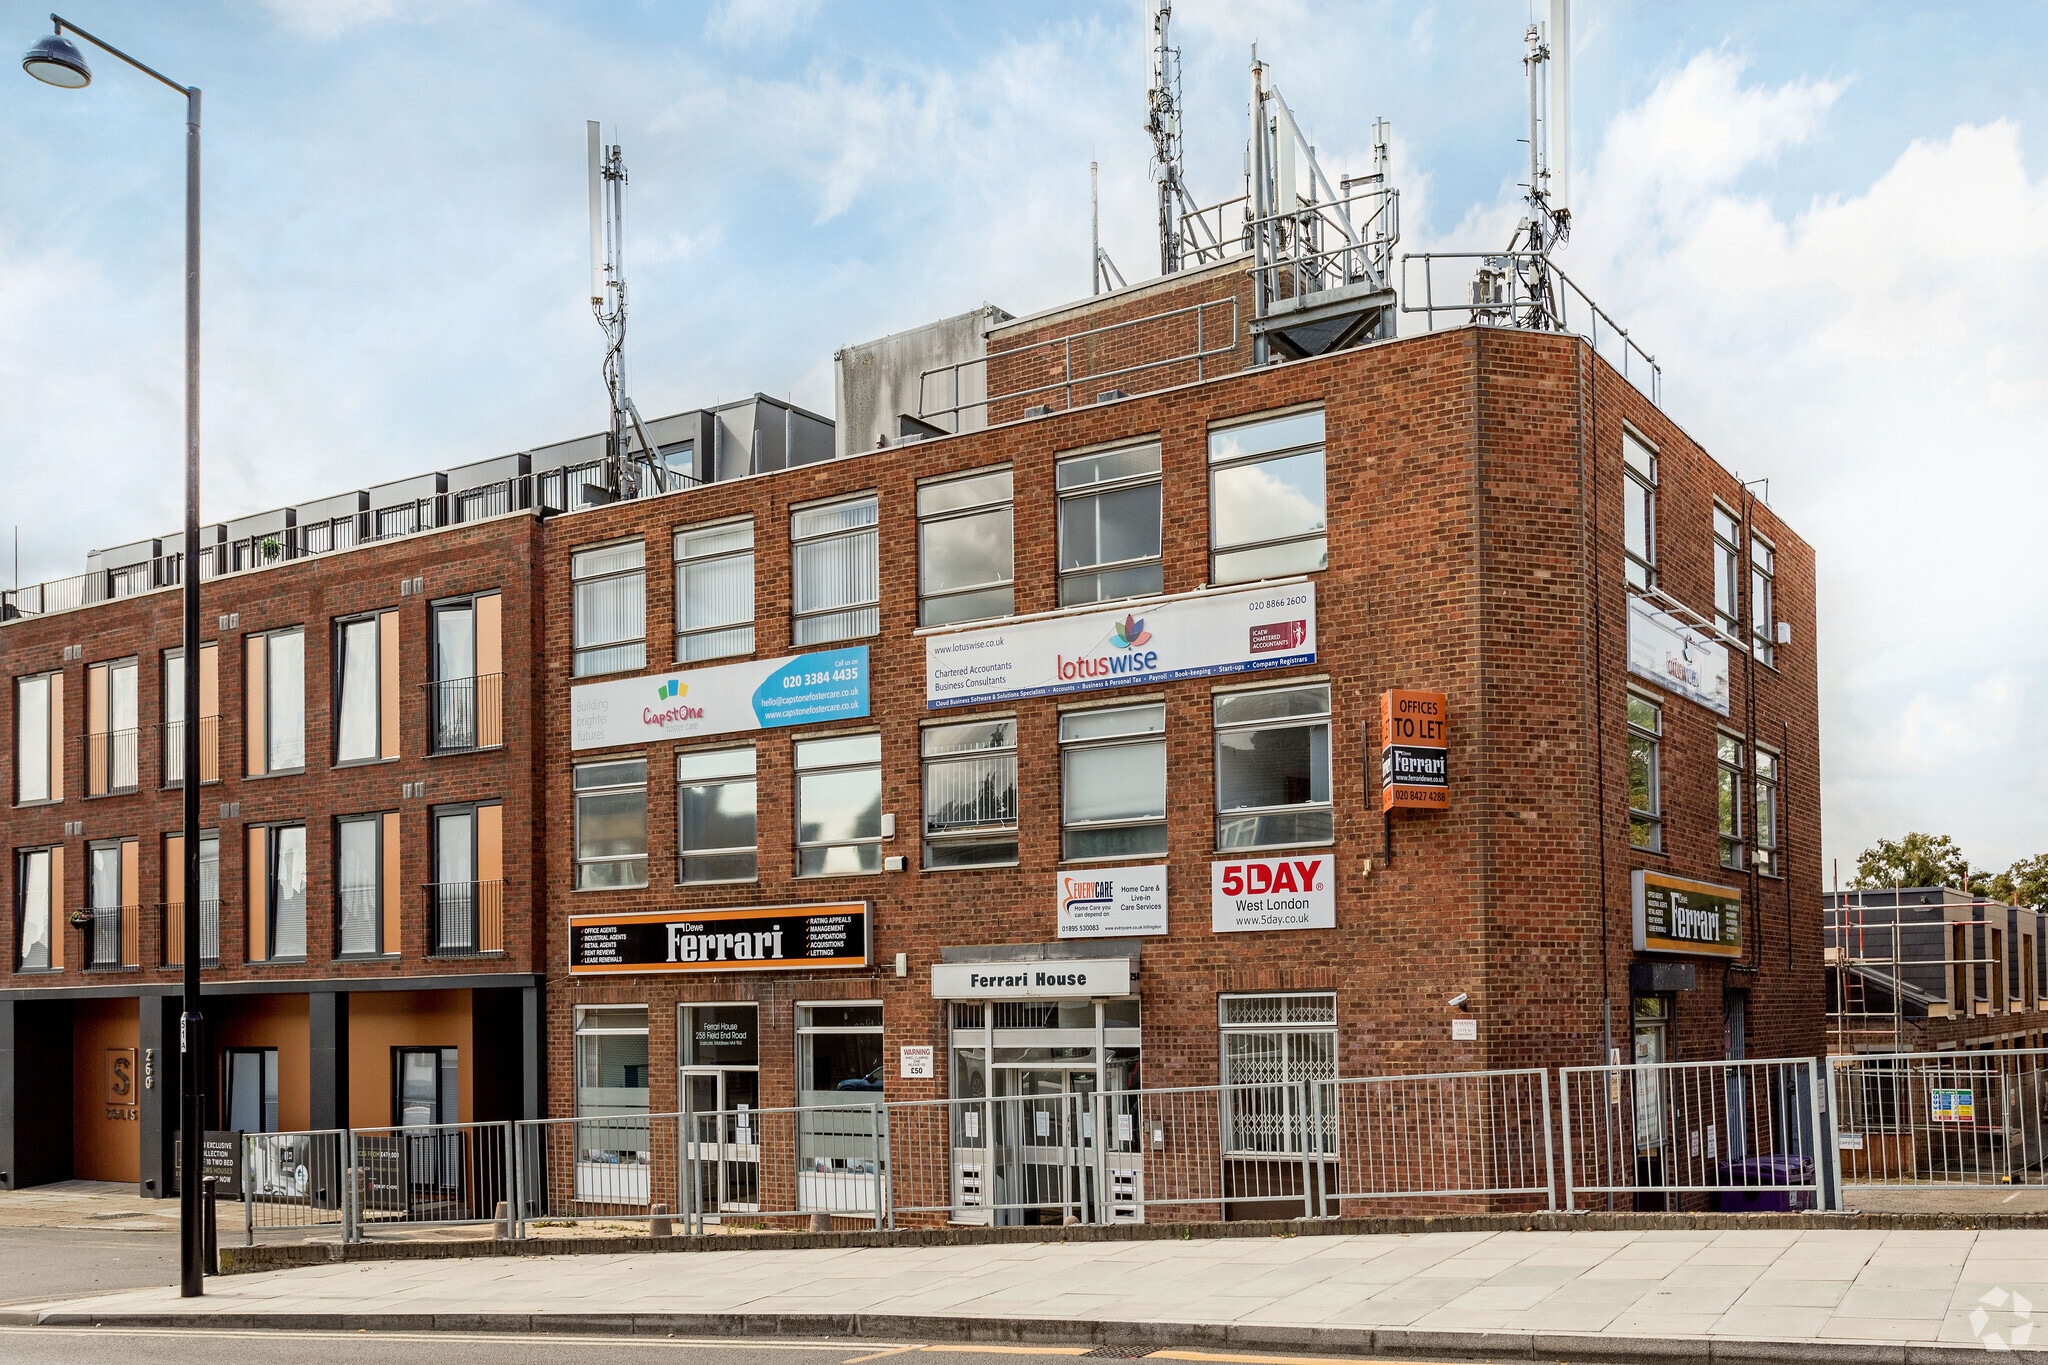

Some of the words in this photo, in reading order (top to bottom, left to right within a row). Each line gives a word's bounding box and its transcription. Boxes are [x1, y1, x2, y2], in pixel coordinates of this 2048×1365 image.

[1249, 602, 1264, 611] 020
[1266, 599, 1285, 609] 8866
[1286, 595, 1307, 606] 2600
[1252, 629, 1268, 637] ICAEW
[1252, 634, 1281, 643] CHARTERED
[934, 637, 1005, 655] www.lotuswise.co.uk
[1252, 640, 1289, 649] ACCOUNTANTS
[935, 666, 968, 679] Chartered
[969, 662, 1012, 674] Accountants
[1057, 647, 1158, 681] lotuswise
[783, 675, 802, 688] 020
[804, 671, 830, 686] 3384
[832, 667, 858, 681] 4435
[935, 681, 964, 692] Business
[965, 676, 1006, 688] Consultants
[950, 697, 970, 706] Business
[970, 695, 992, 703] Software
[997, 692, 1019, 700] Solutions
[1020, 688, 1046, 697] Specialists
[1052, 685, 1075, 693] Accounts
[1082, 682, 1104, 690] Business
[1109, 678, 1131, 686] Personal
[1148, 674, 1168, 682] Payroll
[1174, 668, 1211, 678] Book-keeping
[1218, 664, 1244, 673] Start-ups
[1252, 661, 1279, 669] Company
[1280, 656, 1308, 665] Registrars
[761, 686, 859, 707] hello@capstonefostercare.co.uk
[577, 698, 608, 713] Building
[765, 700, 859, 719] www.capstonefostercare.co.uk
[1400, 700, 1438, 715] OFFICES
[577, 713, 608, 728] brighter
[1394, 718, 1414, 737] TO
[1420, 720, 1443, 739] LET
[577, 730, 605, 742] futures
[1394, 750, 1445, 774] Ferrari
[1396, 790, 1408, 800] 020
[1410, 791, 1427, 801] 8427
[1073, 881, 1113, 899] EVERYCARE
[1236, 899, 1264, 912] West
[1267, 898, 1310, 911] London
[829, 916, 851, 924] APPEALS
[1236, 913, 1310, 925] www.5day.co.uk
[1670, 892, 1720, 941] Ferrari
[685, 923, 703, 932] Dewe
[665, 923, 783, 962] Ferrari
[971, 973, 1028, 988] Ferrari
[1035, 972, 1087, 987] House
